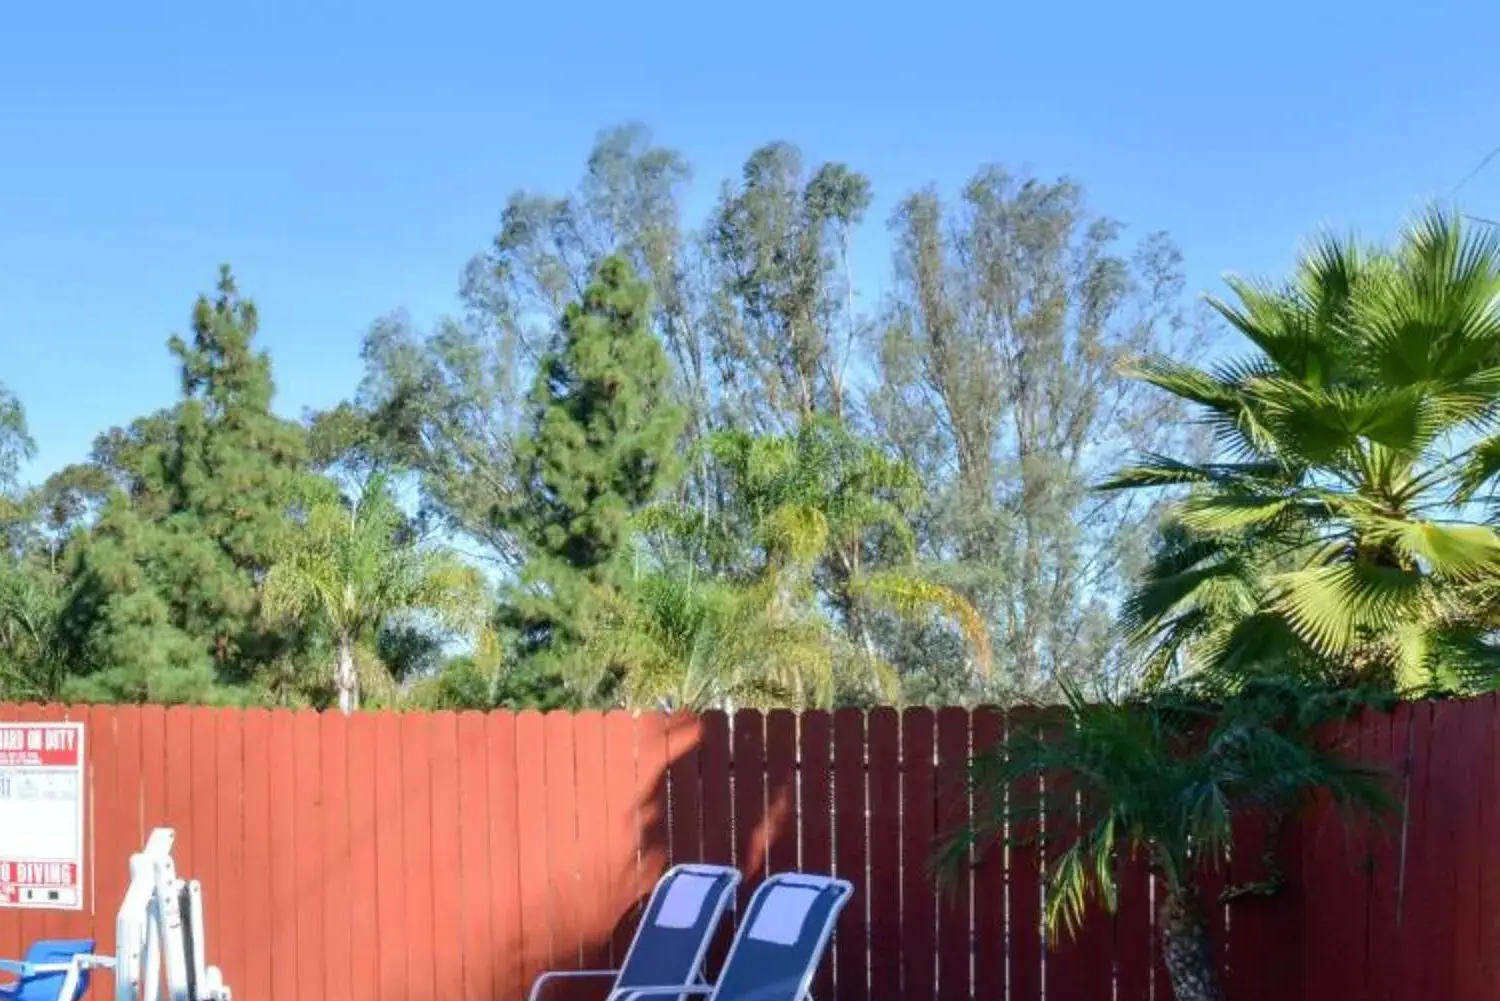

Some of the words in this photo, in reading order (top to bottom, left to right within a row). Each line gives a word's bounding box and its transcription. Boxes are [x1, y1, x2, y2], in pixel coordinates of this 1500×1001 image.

[26, 729, 42, 751] ON
[45, 729, 76, 751] DUTY
[17, 863, 71, 885] DIVING
